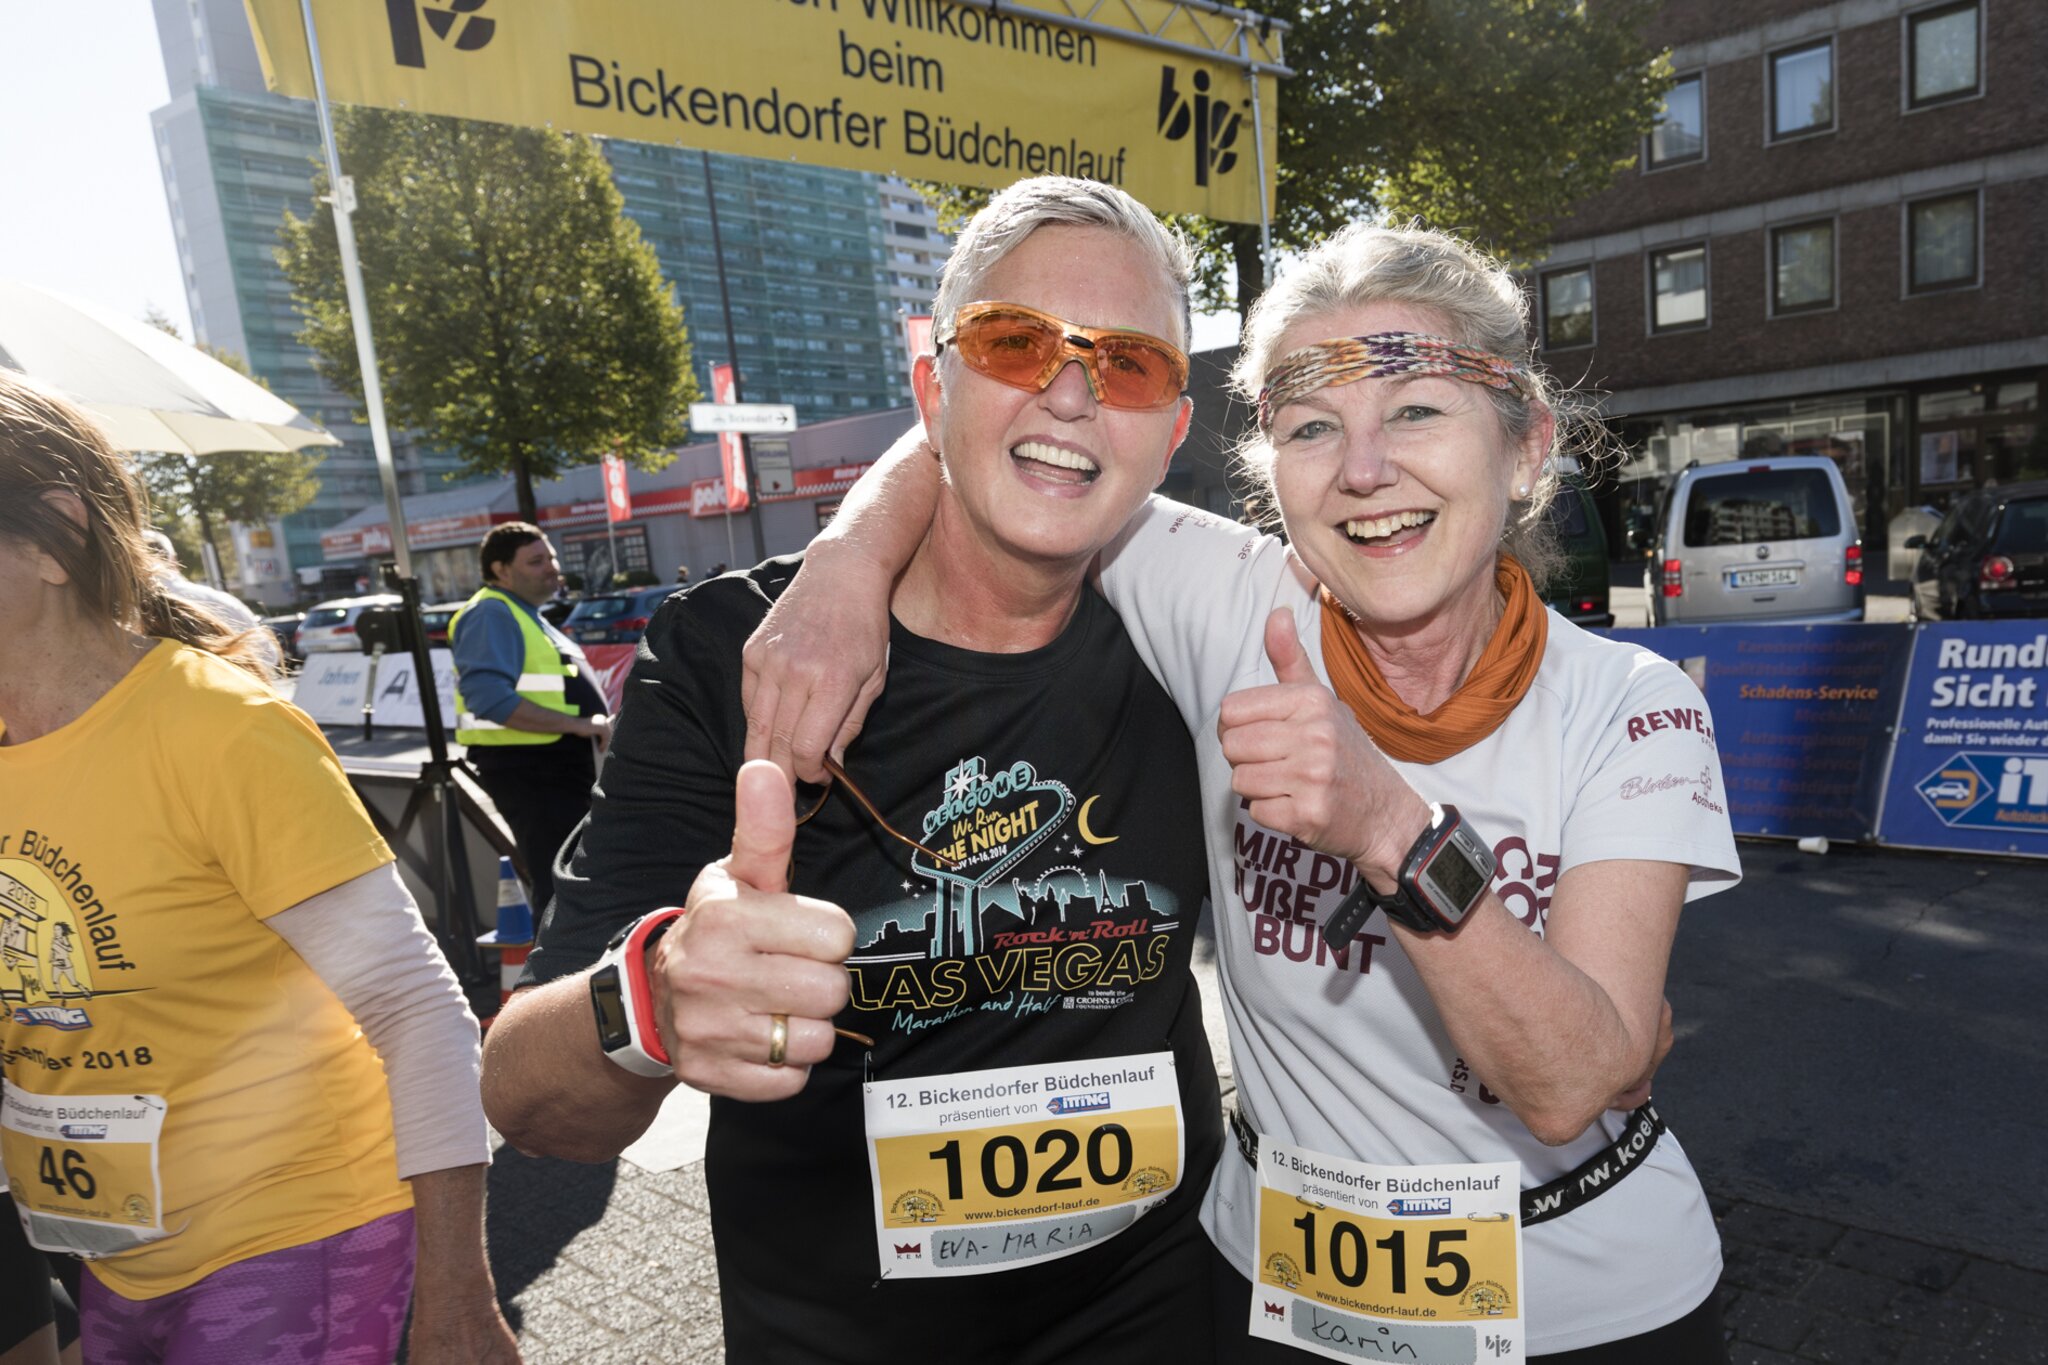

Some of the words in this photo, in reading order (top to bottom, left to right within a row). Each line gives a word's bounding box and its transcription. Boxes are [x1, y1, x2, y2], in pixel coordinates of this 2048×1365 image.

[839, 29, 944, 92] beim
[569, 53, 887, 150] Bickendorfer
[903, 109, 1127, 185] Büdchenlauf
[1938, 634, 2048, 668] Rund
[1739, 684, 1879, 700] Schadens-Service
[1930, 674, 2037, 707] Sicht
[1923, 732, 1963, 744] damit
[1965, 733, 1987, 745] Sie
[1989, 733, 2040, 746] wieder
[1926, 717, 2021, 730] Professionelle
[924, 765, 1029, 832] WELCOME
[953, 817, 974, 840] We
[975, 808, 1003, 830] Run
[971, 800, 1039, 853] NIGHT
[1234, 822, 1302, 880] MIR
[1309, 853, 1361, 896] DI
[7, 881, 37, 910] 2018
[19, 829, 136, 971] Büdchenlauf
[993, 929, 1067, 949] Rock
[1089, 918, 1150, 938] Roll
[1254, 913, 1386, 975] BUNT
[847, 960, 966, 1010] LAS
[976, 935, 1170, 994] VEGAS
[892, 1006, 974, 1036] Marathon
[980, 991, 1013, 1012] and
[1015, 991, 1061, 1018] Half
[82, 1046, 153, 1069] 2018
[886, 1093, 913, 1109] 12.
[919, 1081, 1039, 1106] Bickendorfer
[1044, 1066, 1155, 1092] Büdchenlauf
[57, 1107, 148, 1119] Büdchenlauf
[939, 1105, 1010, 1126] präsentiert
[1015, 1103, 1038, 1115] von
[39, 1146, 96, 1199] 46
[929, 1123, 1133, 1201] 1020
[1271, 1150, 1288, 1167] 12.
[1291, 1157, 1381, 1192] Bickendorfer
[1386, 1175, 1501, 1193] Büdchenlauf
[965, 1198, 1100, 1220] www.bickendorf-lauf.de
[1302, 1183, 1356, 1204] präsentiert
[1358, 1198, 1379, 1209] von
[1293, 1212, 1471, 1297] 1015
[1316, 1290, 1437, 1317] www.bickendorf-lauf.de
